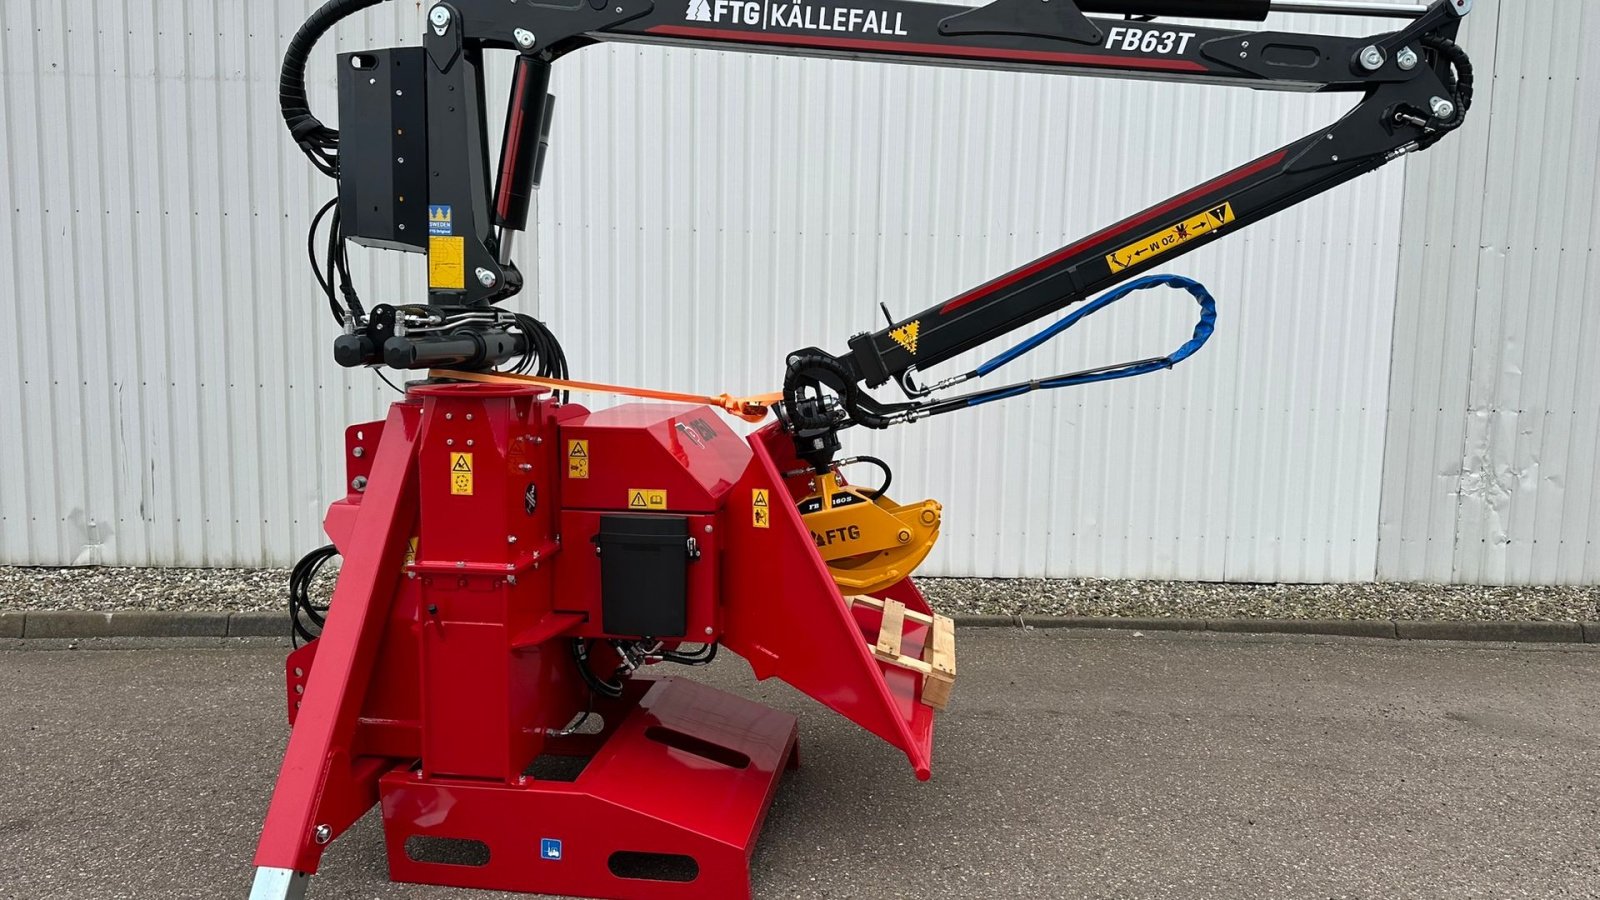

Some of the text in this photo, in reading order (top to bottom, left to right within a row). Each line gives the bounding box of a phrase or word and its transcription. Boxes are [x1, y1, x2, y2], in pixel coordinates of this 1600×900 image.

[713, 0, 908, 36] FTG KÄLLEFALL
[1105, 27, 1196, 54] FB63T
[1149, 234, 1175, 252] 20 M
[832, 496, 853, 505] 160S
[825, 525, 860, 545] FTG
